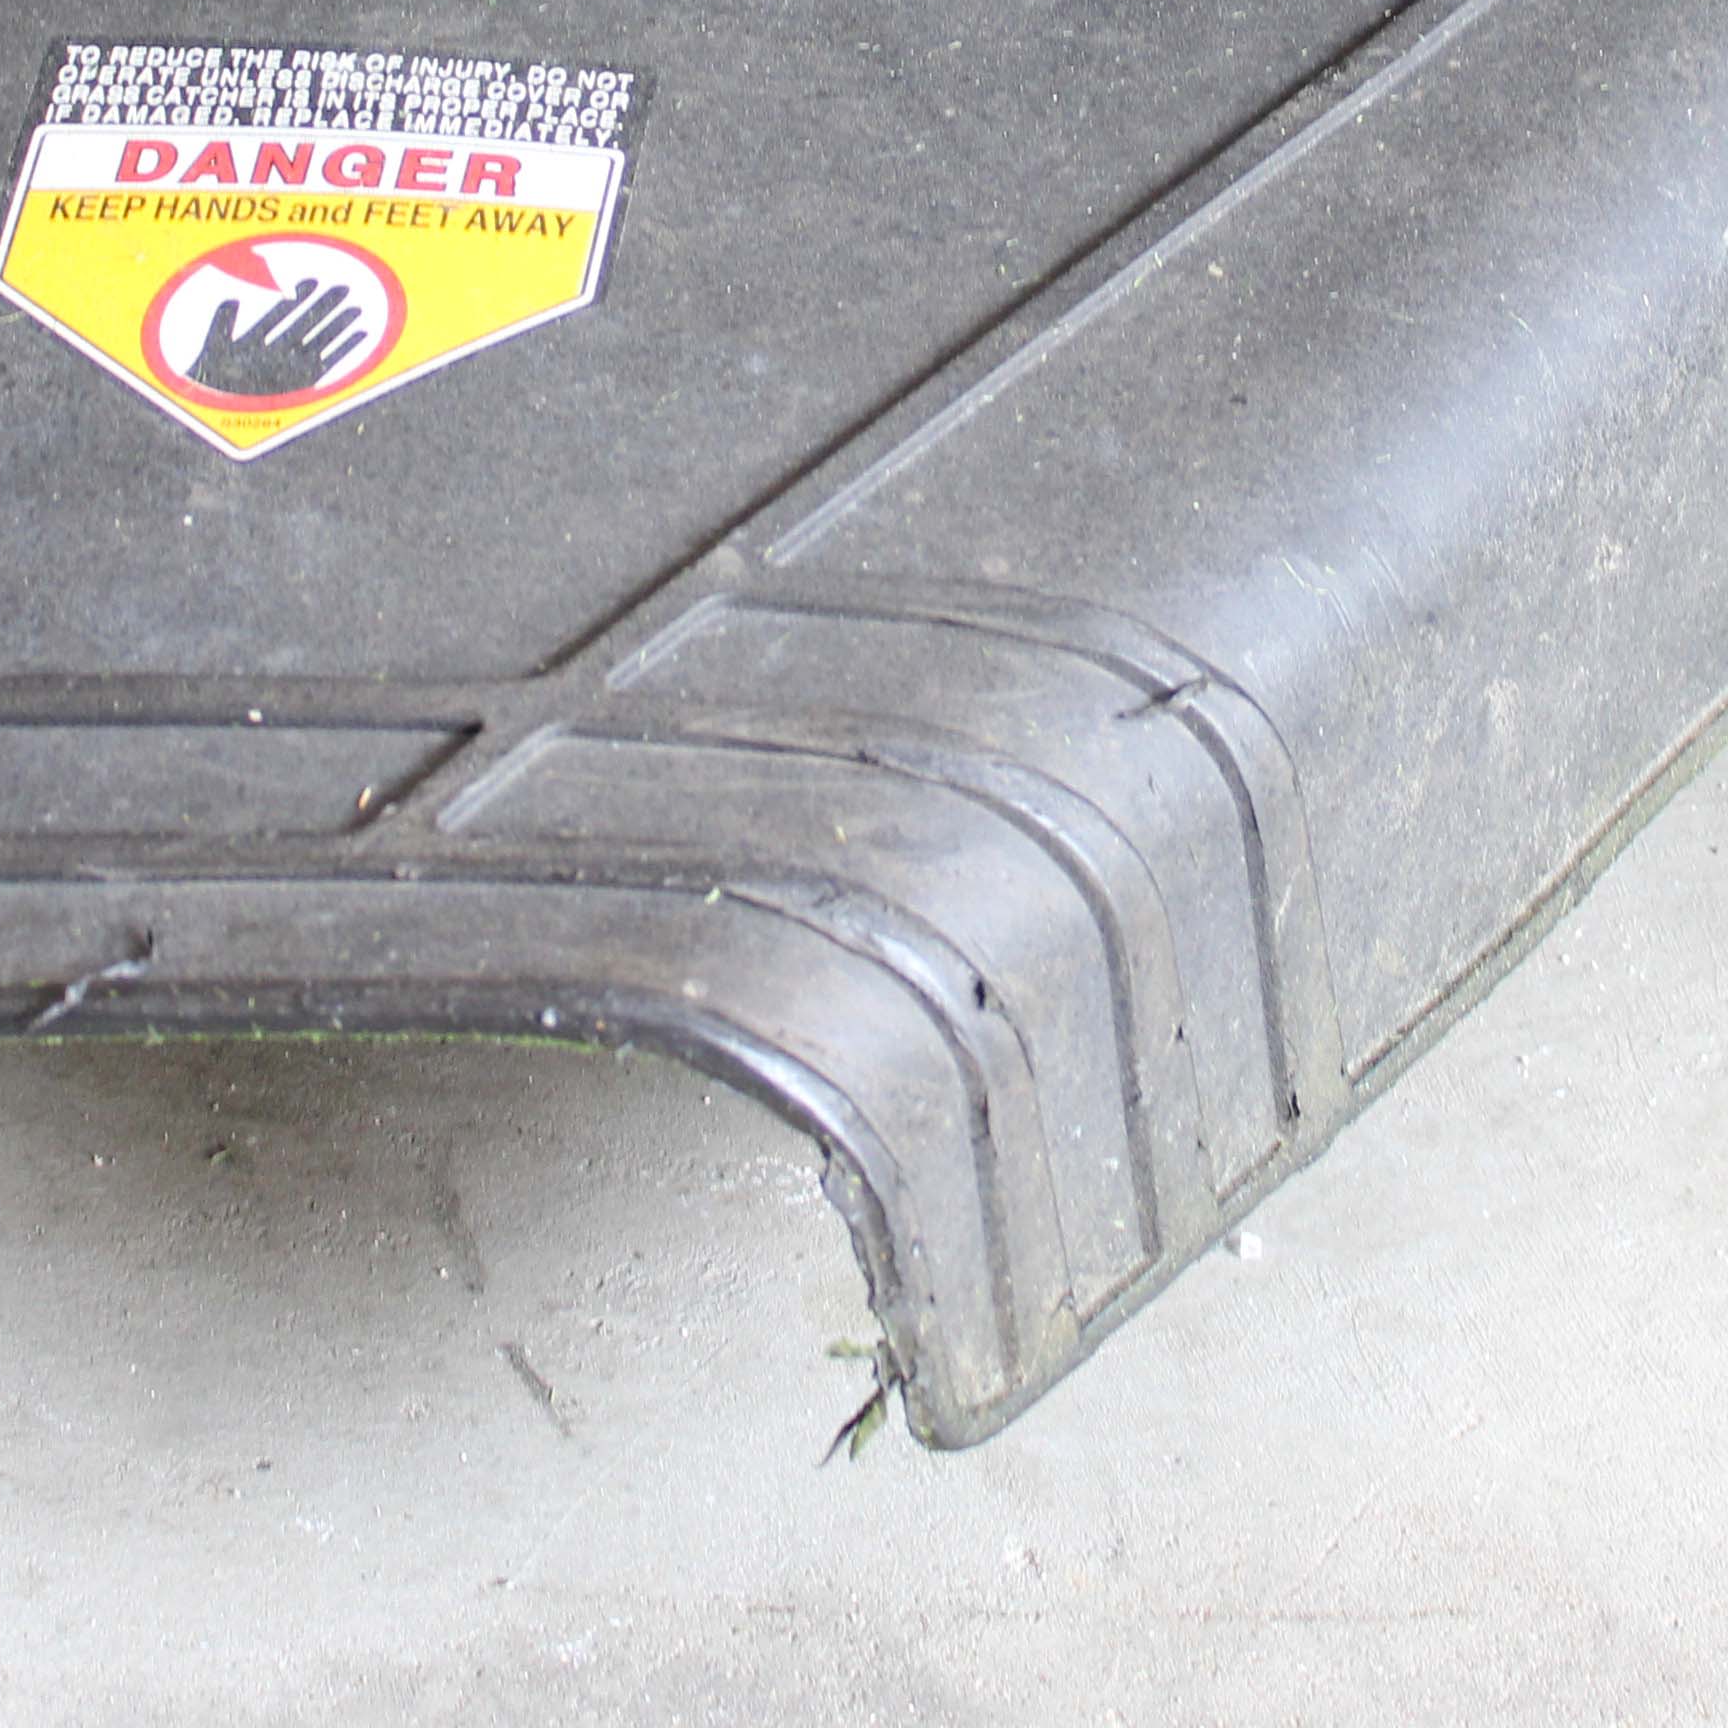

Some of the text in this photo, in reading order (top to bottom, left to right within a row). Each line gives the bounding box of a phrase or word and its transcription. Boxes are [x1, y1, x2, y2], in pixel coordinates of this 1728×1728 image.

[58, 64, 630, 112] OPERATE UNLESS DISCHARGE COVER OR
[67, 45, 634, 92] TO REDUCE THE RISK OF INJURY, DO NOT
[45, 102, 619, 149] IF DAMAGED, REPLACE IMMEDIATELY.
[52, 84, 623, 132] GRASS CATCHER IS IN ITS PROPER PLACE.
[114, 139, 522, 197] DANGER
[49, 194, 576, 238] KEEP HANDS and FEET AWAY
